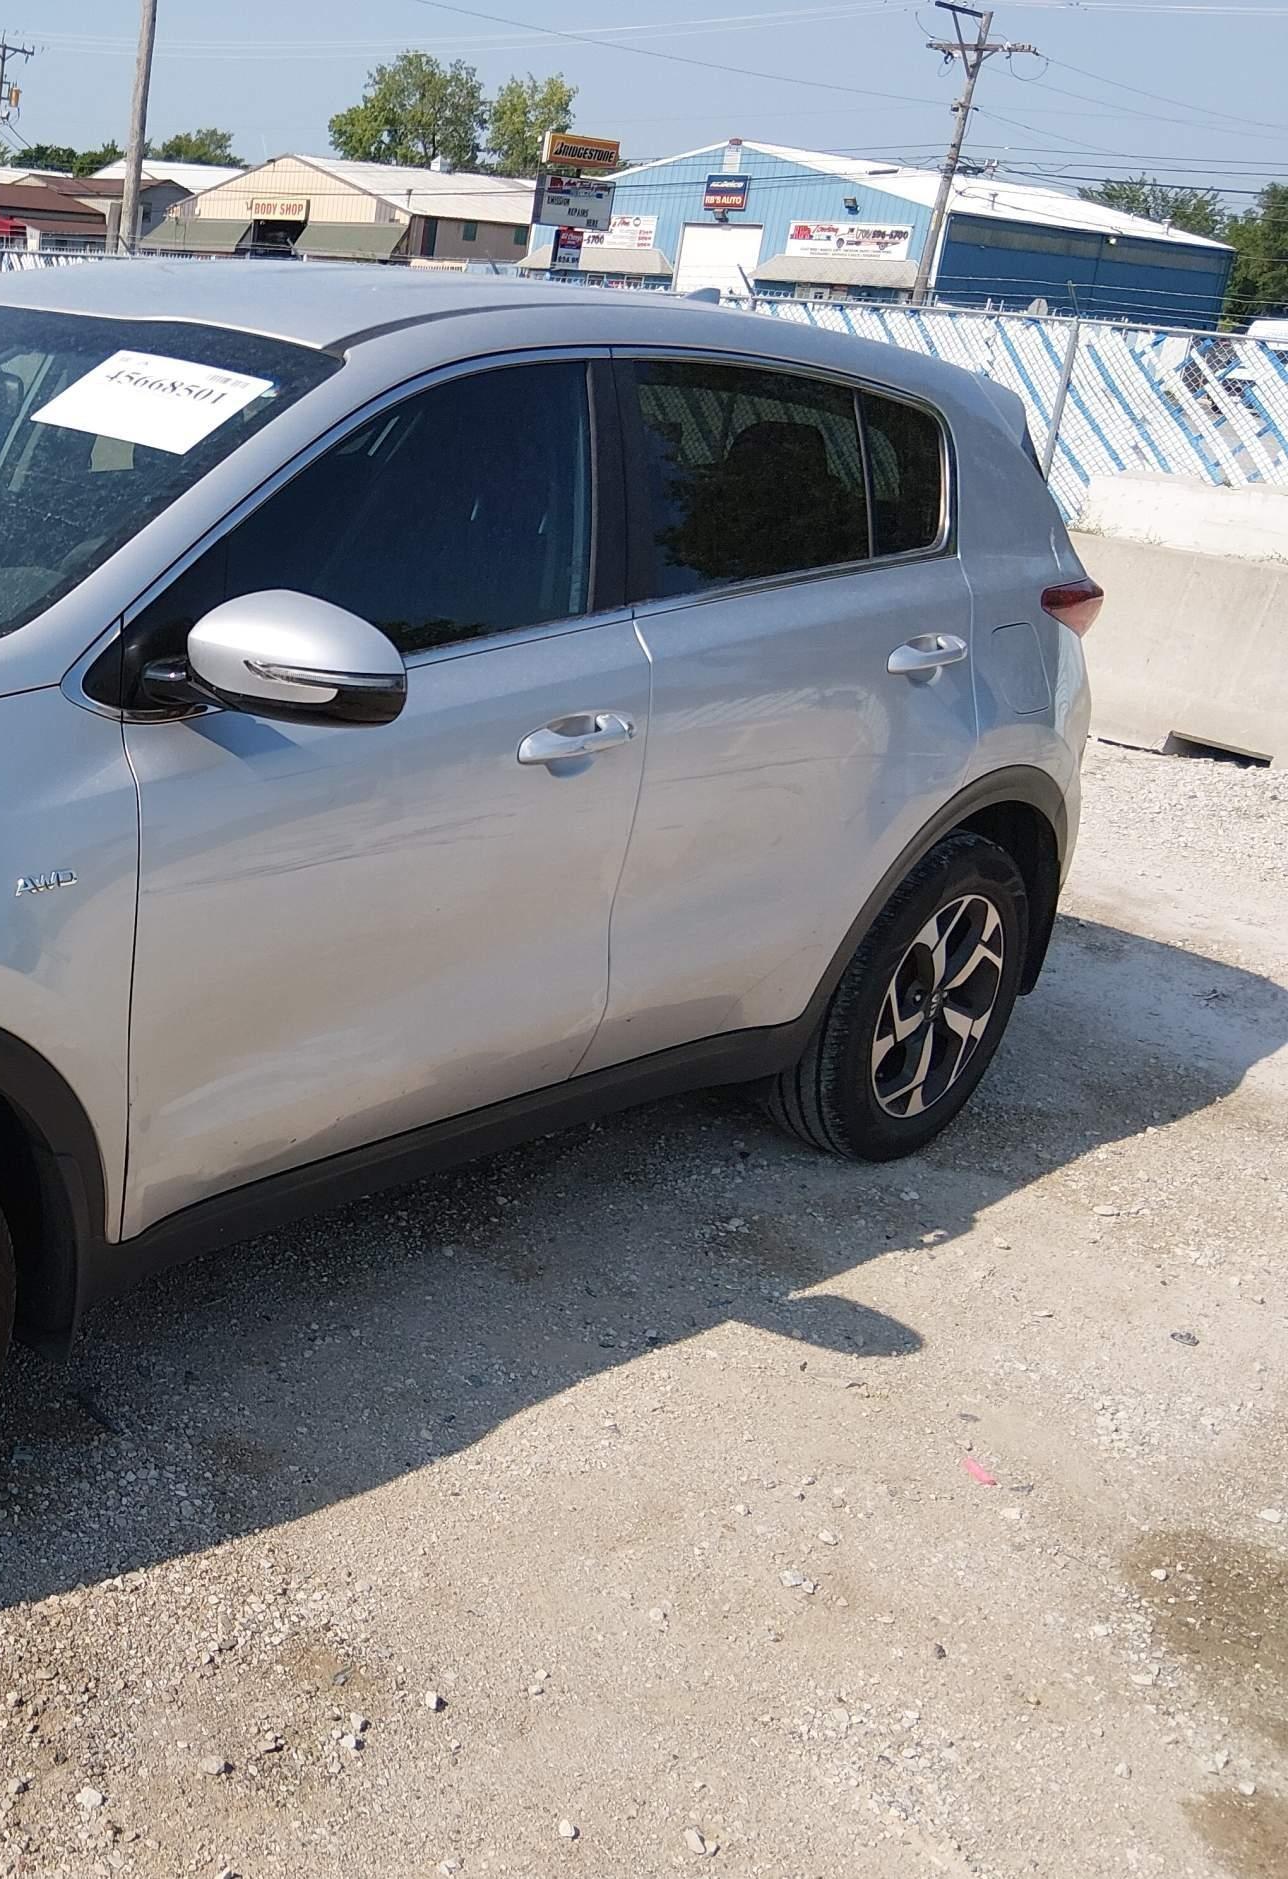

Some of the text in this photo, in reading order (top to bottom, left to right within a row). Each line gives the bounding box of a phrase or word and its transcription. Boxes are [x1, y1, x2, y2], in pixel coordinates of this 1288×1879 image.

[554, 142, 616, 163] BRIDGESTONE
[546, 195, 571, 207] EMISSION
[722, 196, 742, 205] AUTO
[254, 202, 304, 216] BODY SHOP
[567, 207, 589, 218] REPAIRS
[105, 369, 229, 405] 45668501
[15, 870, 78, 897] AWD
